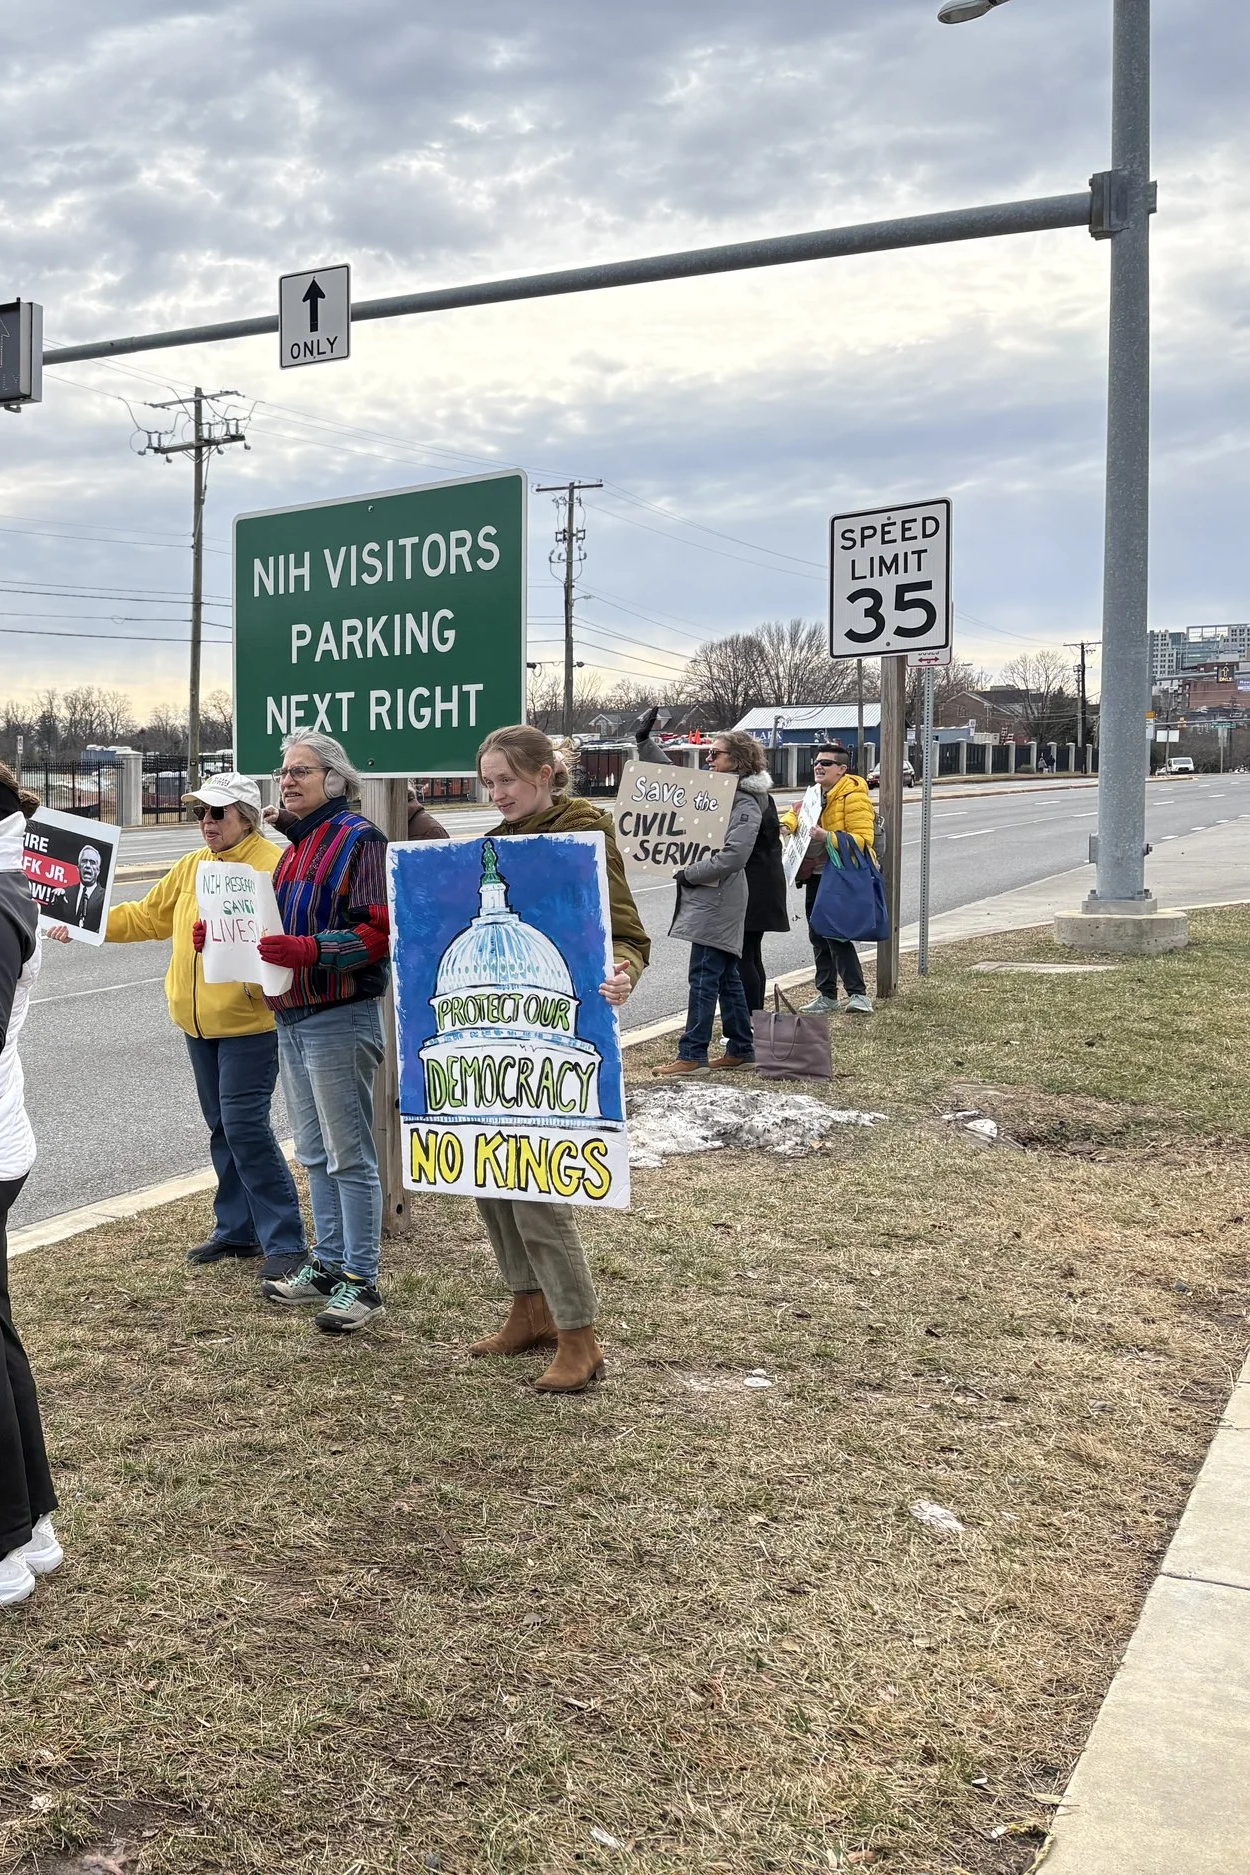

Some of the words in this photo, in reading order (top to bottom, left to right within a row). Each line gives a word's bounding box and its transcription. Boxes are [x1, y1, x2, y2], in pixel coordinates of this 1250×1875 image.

[290, 336, 338, 360] ONLY
[840, 515, 940, 551] SPEED
[253, 551, 310, 597] NIH
[323, 525, 500, 588] VISITORS
[851, 548, 928, 581] LIMIT
[844, 580, 937, 644] 35
[291, 608, 456, 664] PARKING
[266, 691, 355, 735] NEXT
[369, 683, 484, 731] RIGHT
[631, 776, 687, 808] Save
[694, 790, 719, 812] the
[618, 810, 687, 837] CIVIL
[24, 831, 49, 853] IRE
[22, 855, 42, 875] FK
[45, 864, 68, 884] JR.
[203, 874, 221, 895] NIH
[210, 918, 257, 943] LIVES
[438, 992, 523, 1032] PROTECT
[522, 994, 571, 1032] OUR
[430, 1055, 595, 1113] DEMOCRACY
[409, 1127, 464, 1186] NO
[474, 1130, 613, 1200] KINGS
